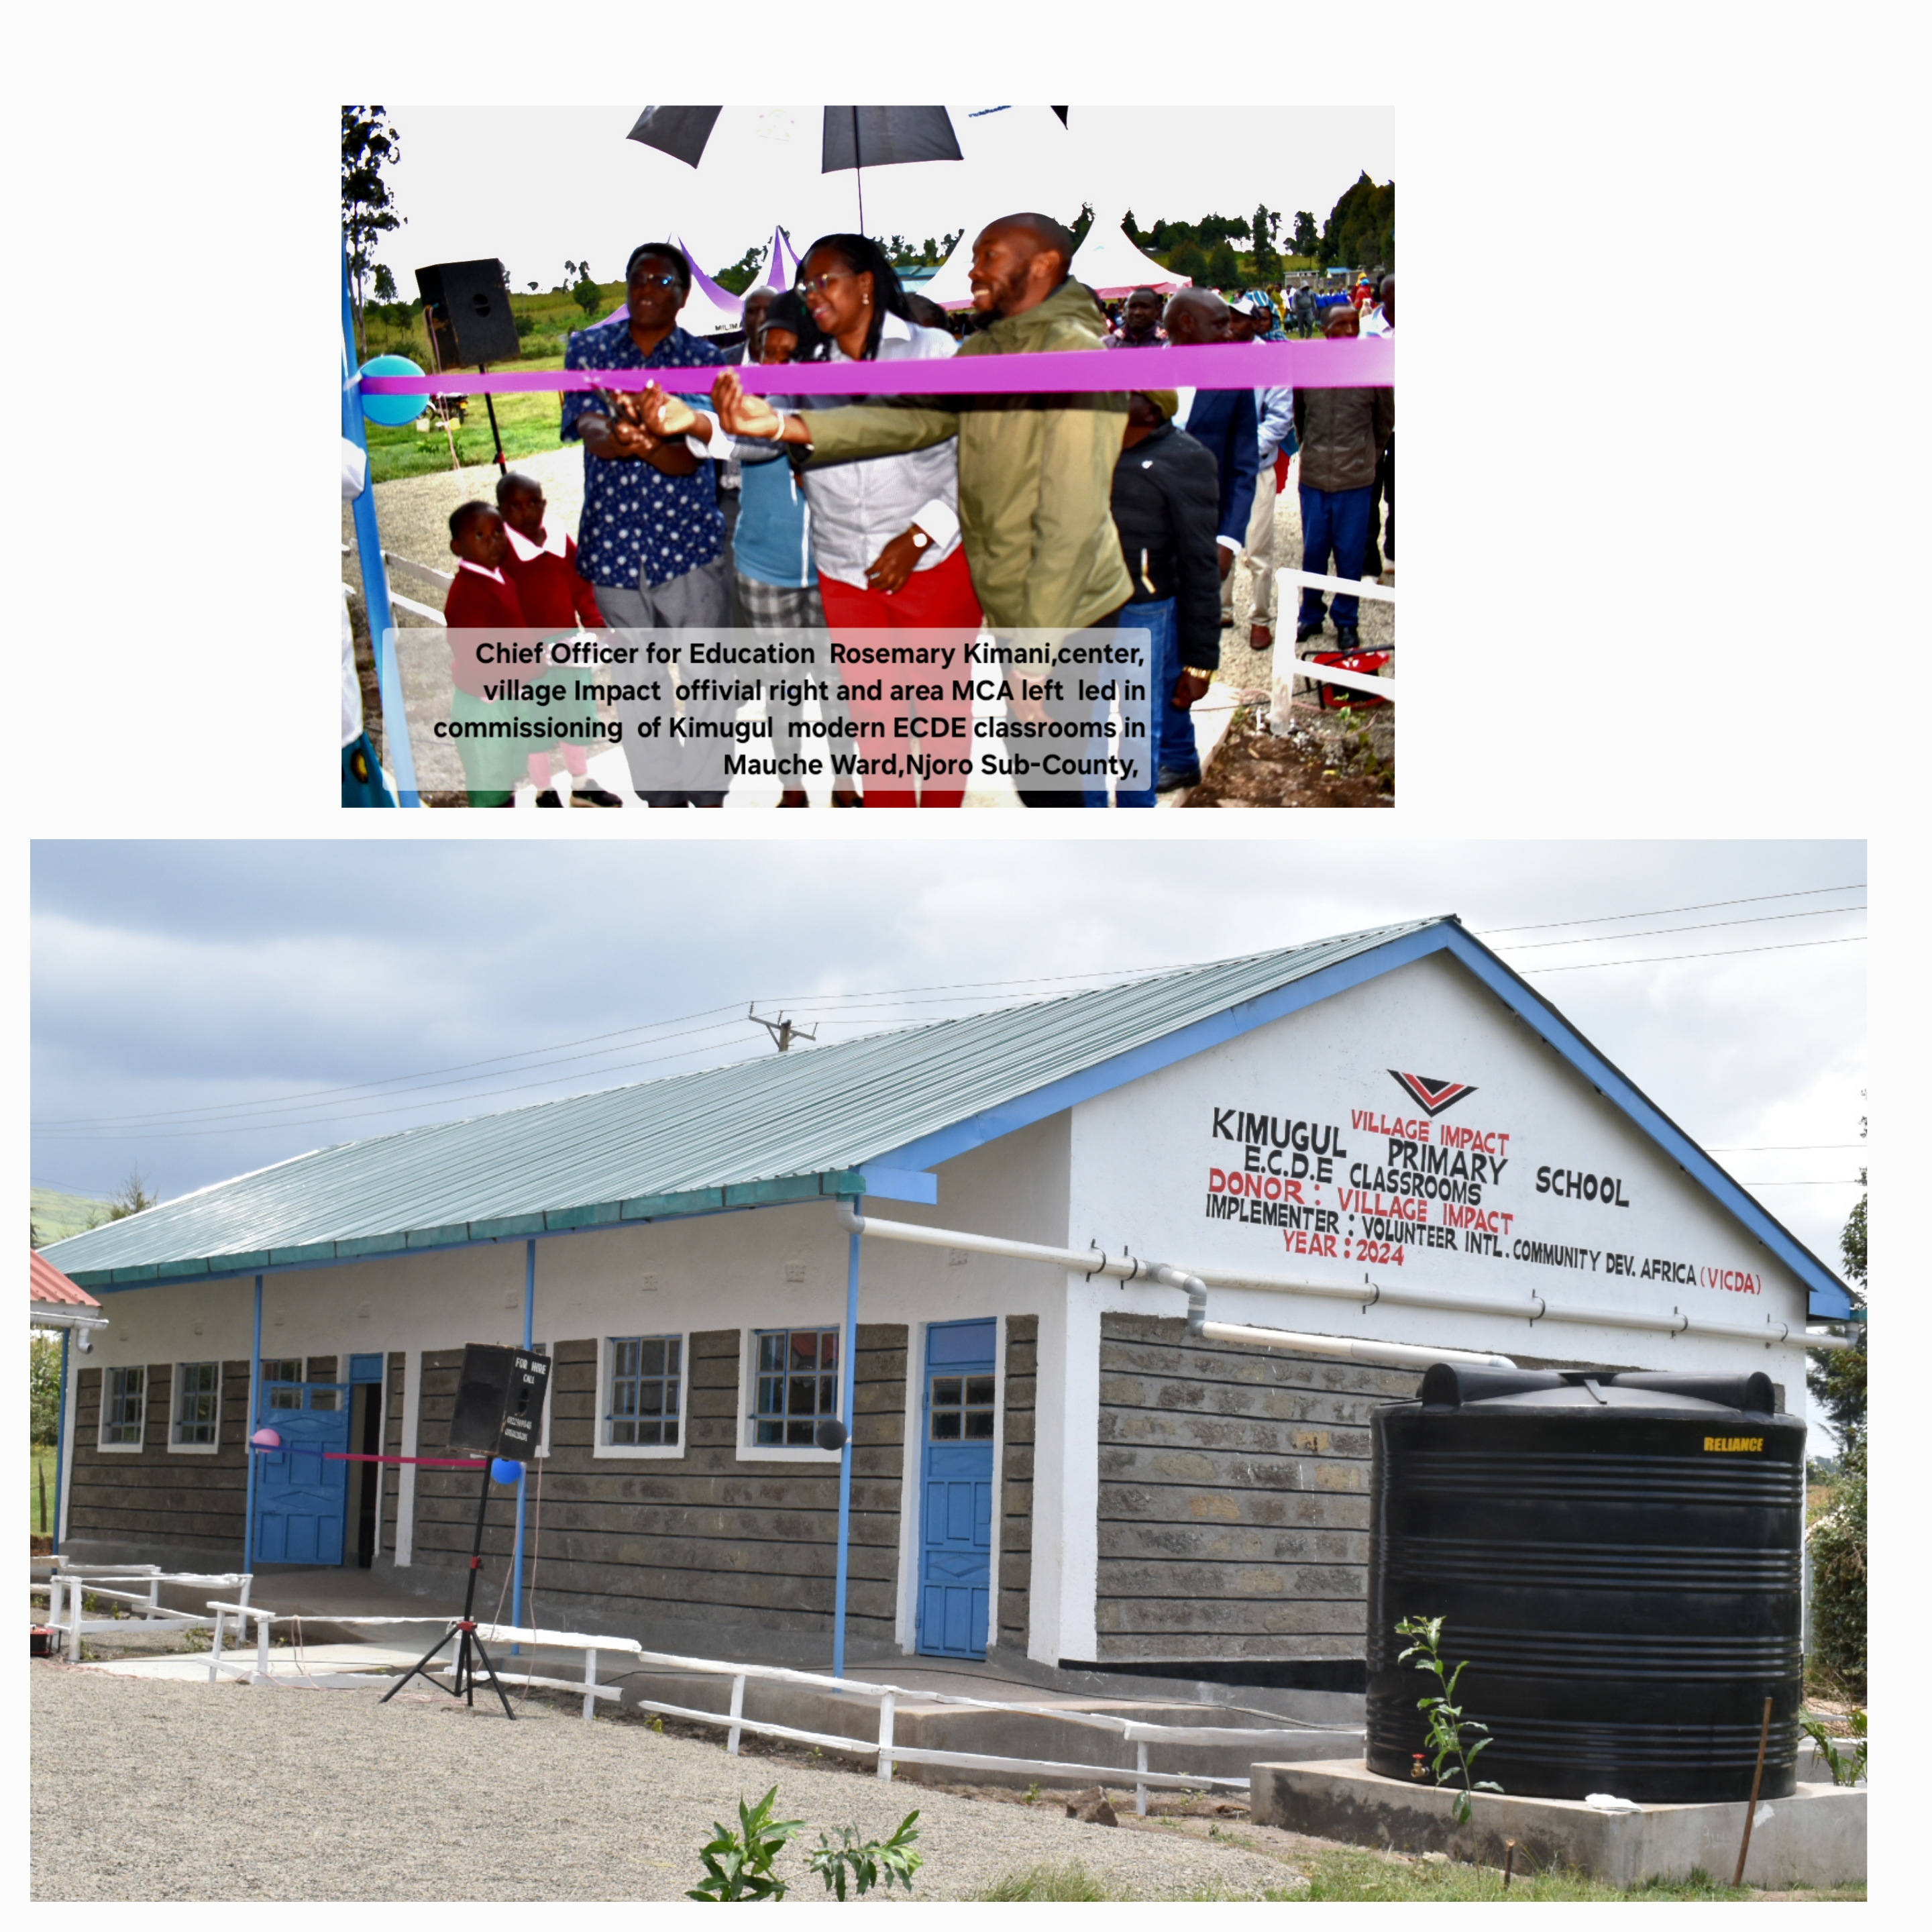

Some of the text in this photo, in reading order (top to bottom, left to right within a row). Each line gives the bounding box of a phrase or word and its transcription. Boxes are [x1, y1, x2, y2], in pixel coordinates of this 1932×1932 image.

[1351, 1109, 1509, 1156] VILLAGE IMPACT
[1212, 1107, 1630, 1208] KIMUGUL PRIMARY SCHOOL
[1244, 1144, 1482, 1205] E.C.D.E CLASSROOMS
[1338, 1187, 1428, 1222] VILLAGE
[1443, 1203, 1513, 1235] IMPACT
[1356, 1239, 1405, 1266] 2024
[1362, 1216, 1458, 1251] VOLUNTEER
[1465, 1230, 1509, 1258] INTL.
[1513, 1238, 1601, 1271] COMMUNITY
[1605, 1252, 1636, 1277] DEV.
[1640, 1258, 1697, 1287] AFRICA
[1700, 1266, 1762, 1295] (VICDA)
[516, 1358, 547, 1375] FOR HIRE
[523, 1374, 535, 1384] CALL
[1704, 1437, 1764, 1452] RELIANCE
